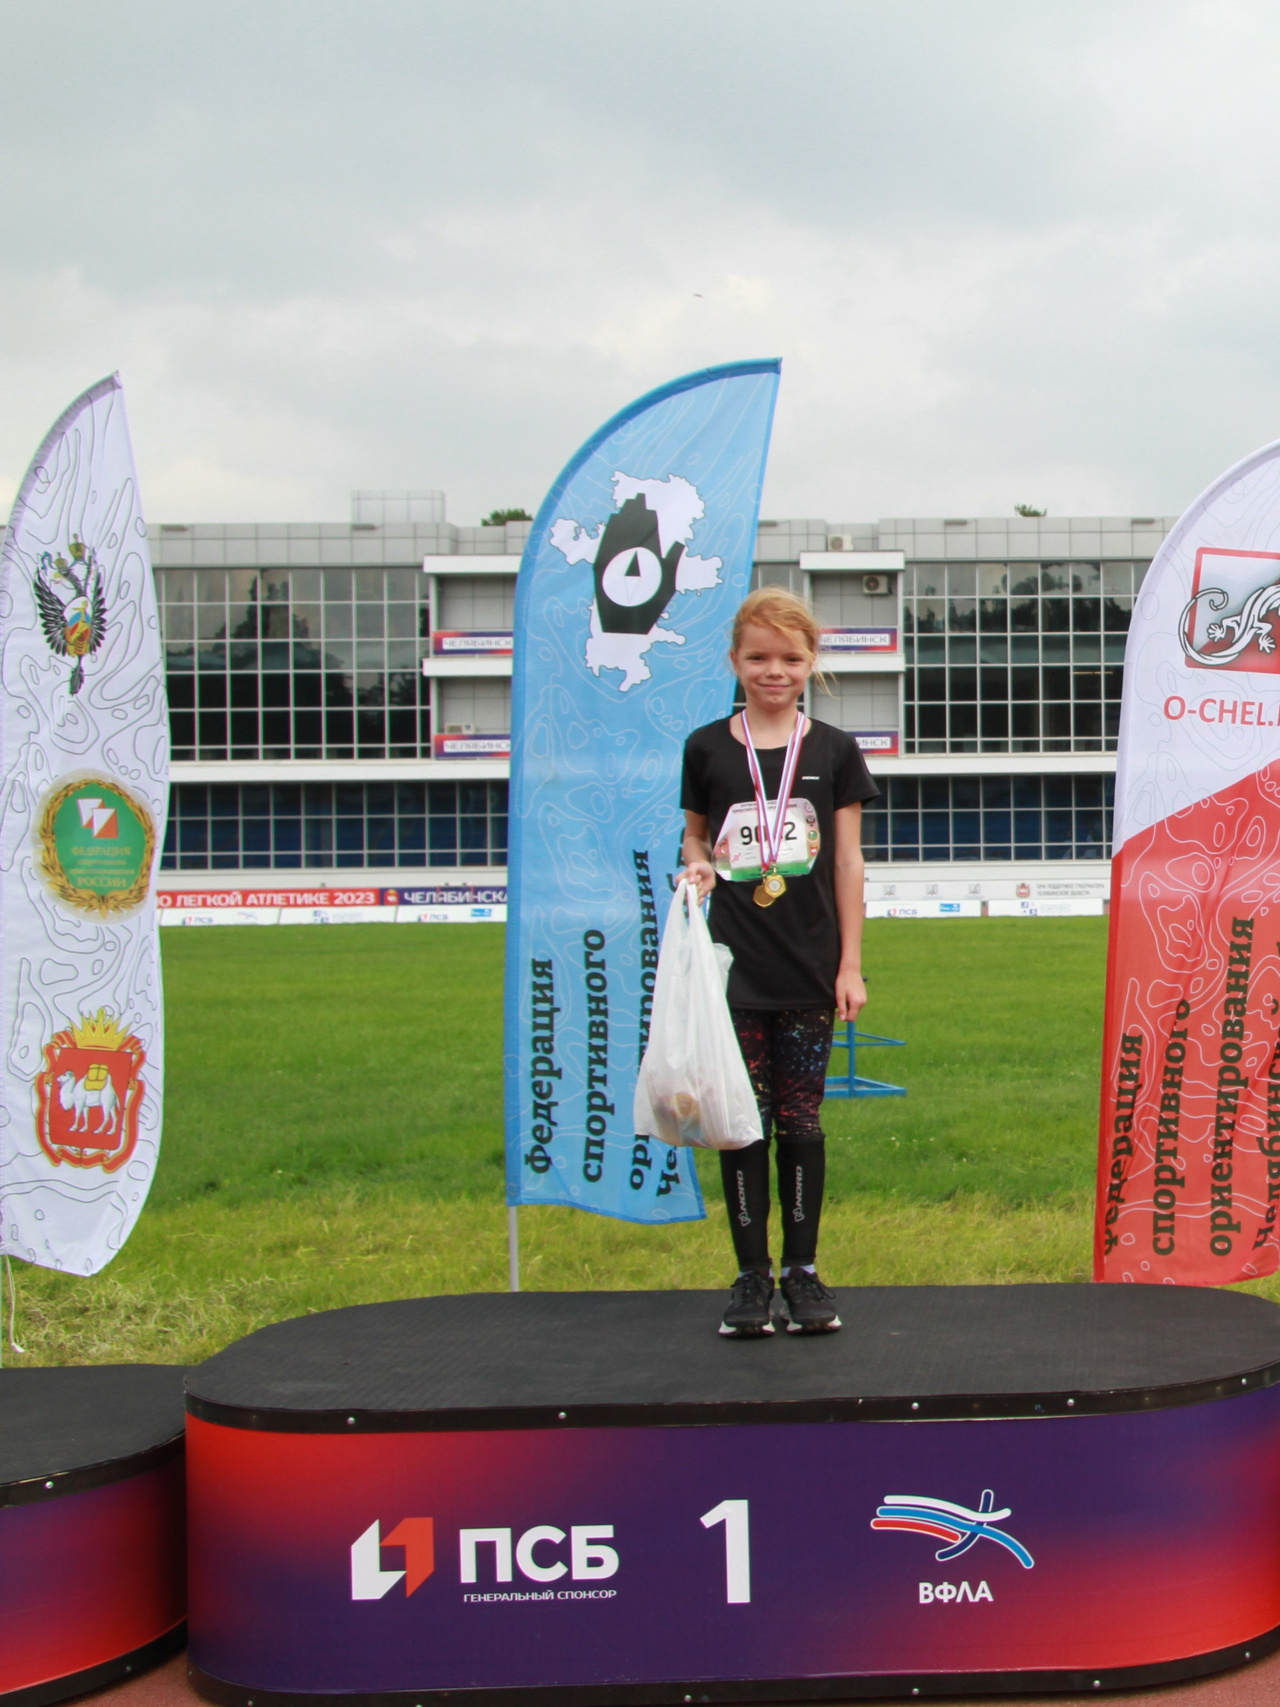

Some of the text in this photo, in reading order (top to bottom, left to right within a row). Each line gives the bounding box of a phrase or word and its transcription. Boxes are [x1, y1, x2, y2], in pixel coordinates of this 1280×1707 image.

[443, 637, 512, 647] ЧЕЛЯБИНСК
[740, 821, 797, 845] 902
[77, 876, 127, 887] РОССИИ
[176, 891, 240, 907] ЛЕГКОЙ
[246, 892, 329, 906] АТЛЕТИКЕ
[333, 891, 376, 904] 2023
[524, 958, 562, 1174] Федерация
[583, 929, 615, 1183] спортивного
[1209, 916, 1255, 1256] ориентирования
[1152, 999, 1191, 1256] спортивного
[459, 1525, 620, 1584] ПСБ
[700, 1499, 751, 1604] 1
[463, 1589, 618, 1603] ГЕНЕРАЛЬНЫЙ СПОНСОР
[918, 1580, 995, 1604] ВФЛА
